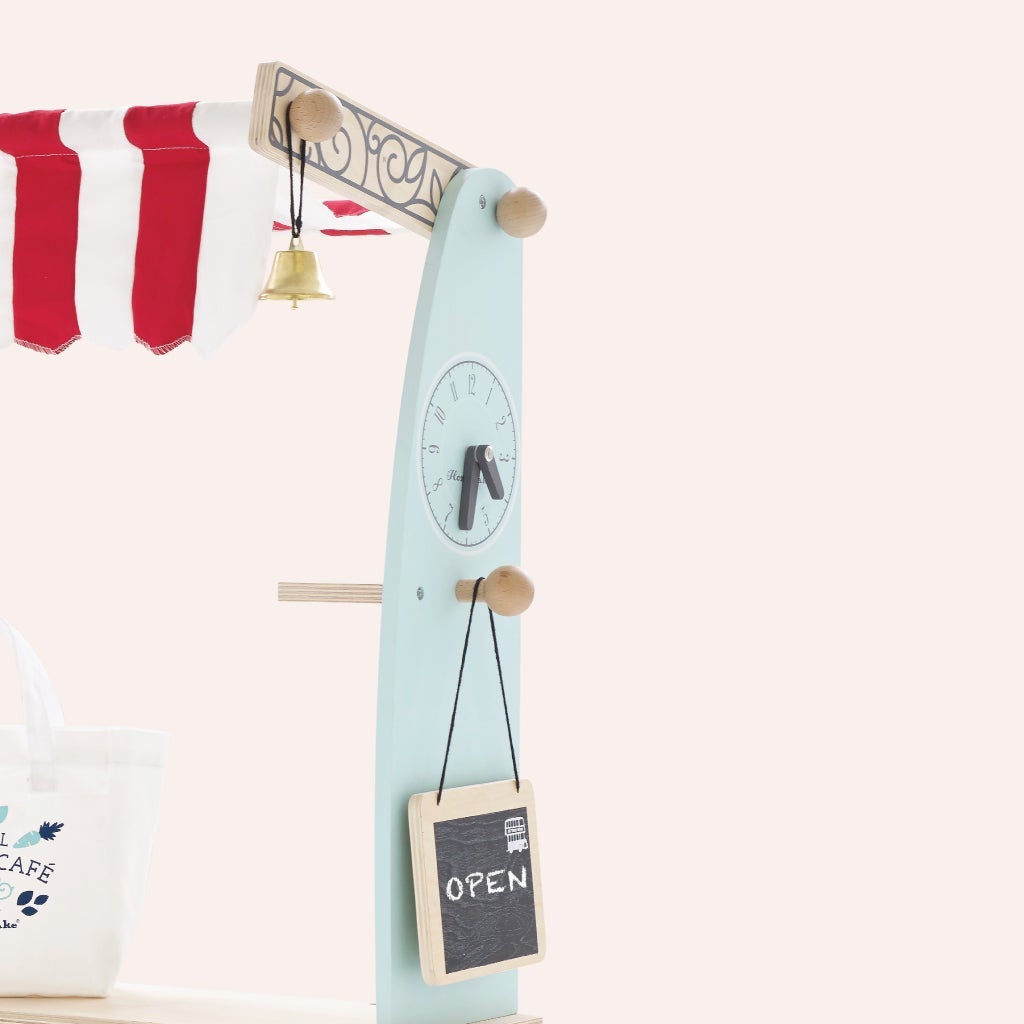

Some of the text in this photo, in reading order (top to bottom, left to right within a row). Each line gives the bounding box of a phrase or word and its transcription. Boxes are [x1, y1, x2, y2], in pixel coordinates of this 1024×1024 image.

[450, 381, 458, 402] 11
[468, 373, 476, 396] 12
[434, 405, 446, 425] 10
[496, 415, 507, 430] 2
[428, 444, 440, 454] 9
[499, 452, 510, 463] 3
[433, 477, 443, 492] 8
[446, 866, 527, 901] OPEN
